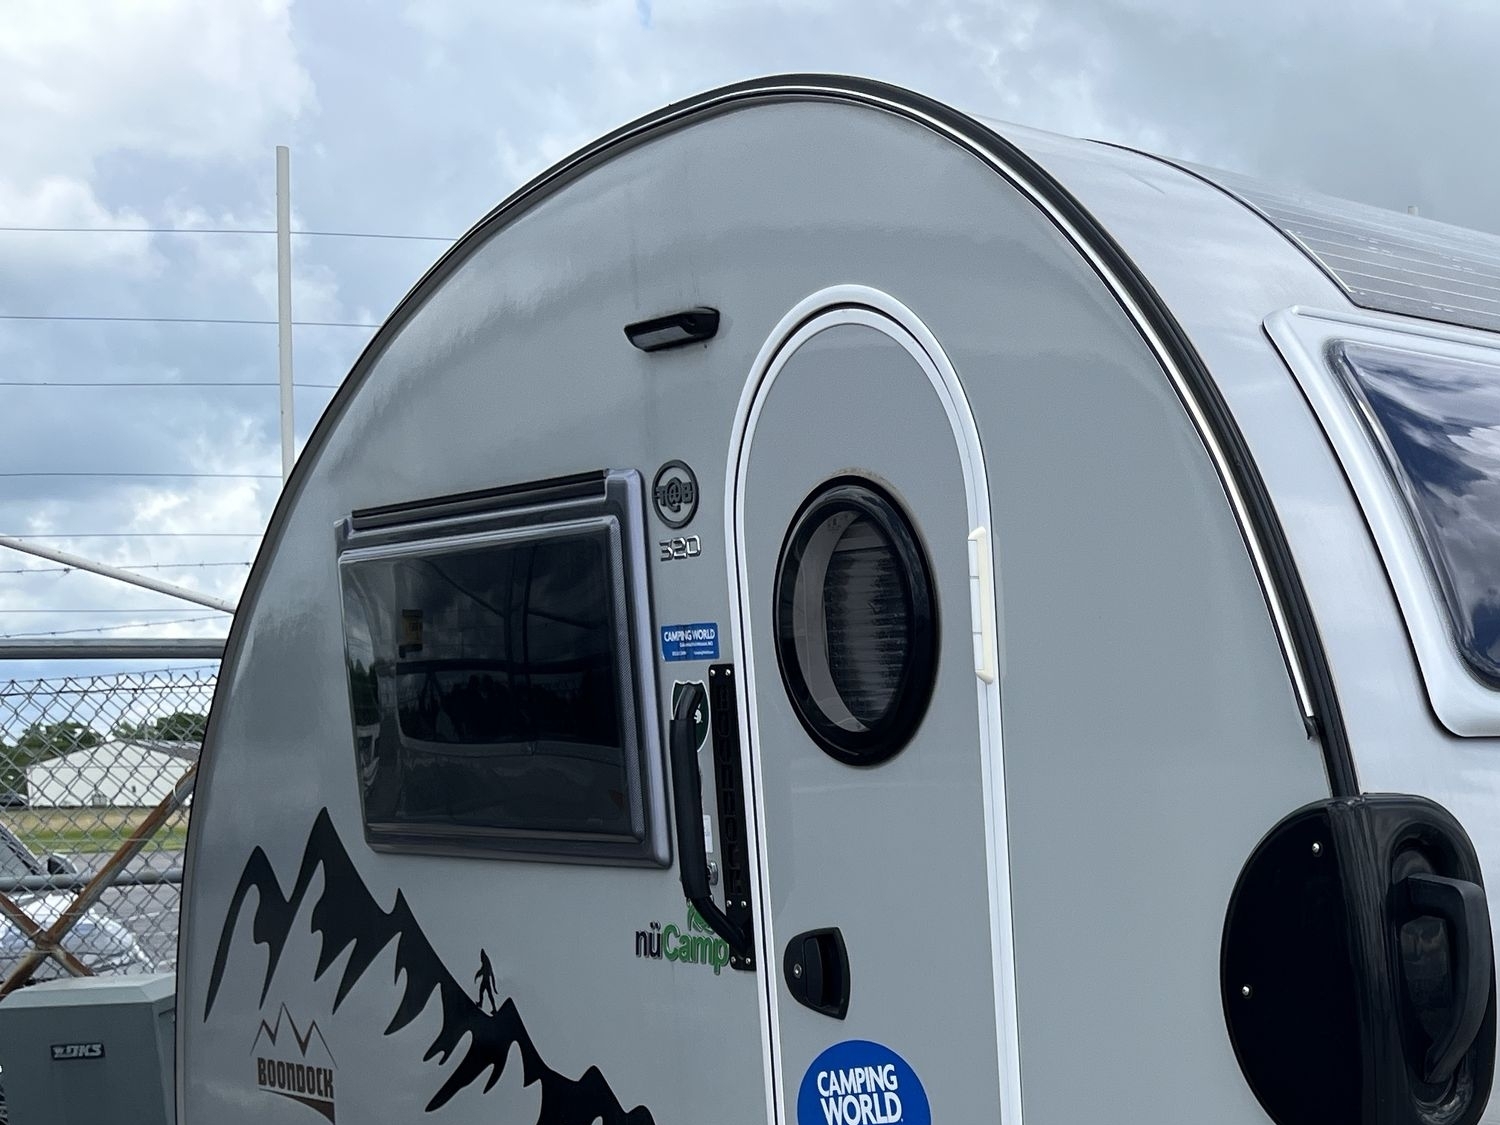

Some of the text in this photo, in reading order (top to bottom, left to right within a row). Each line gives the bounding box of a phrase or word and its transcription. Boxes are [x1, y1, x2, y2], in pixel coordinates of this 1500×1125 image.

[659, 535, 701, 562] 320
[663, 628, 716, 642] CAMPING WORLD
[635, 920, 730, 976] nüCamp
[257, 1056, 335, 1100] BOONDOCK
[817, 1064, 899, 1097] CAMPING
